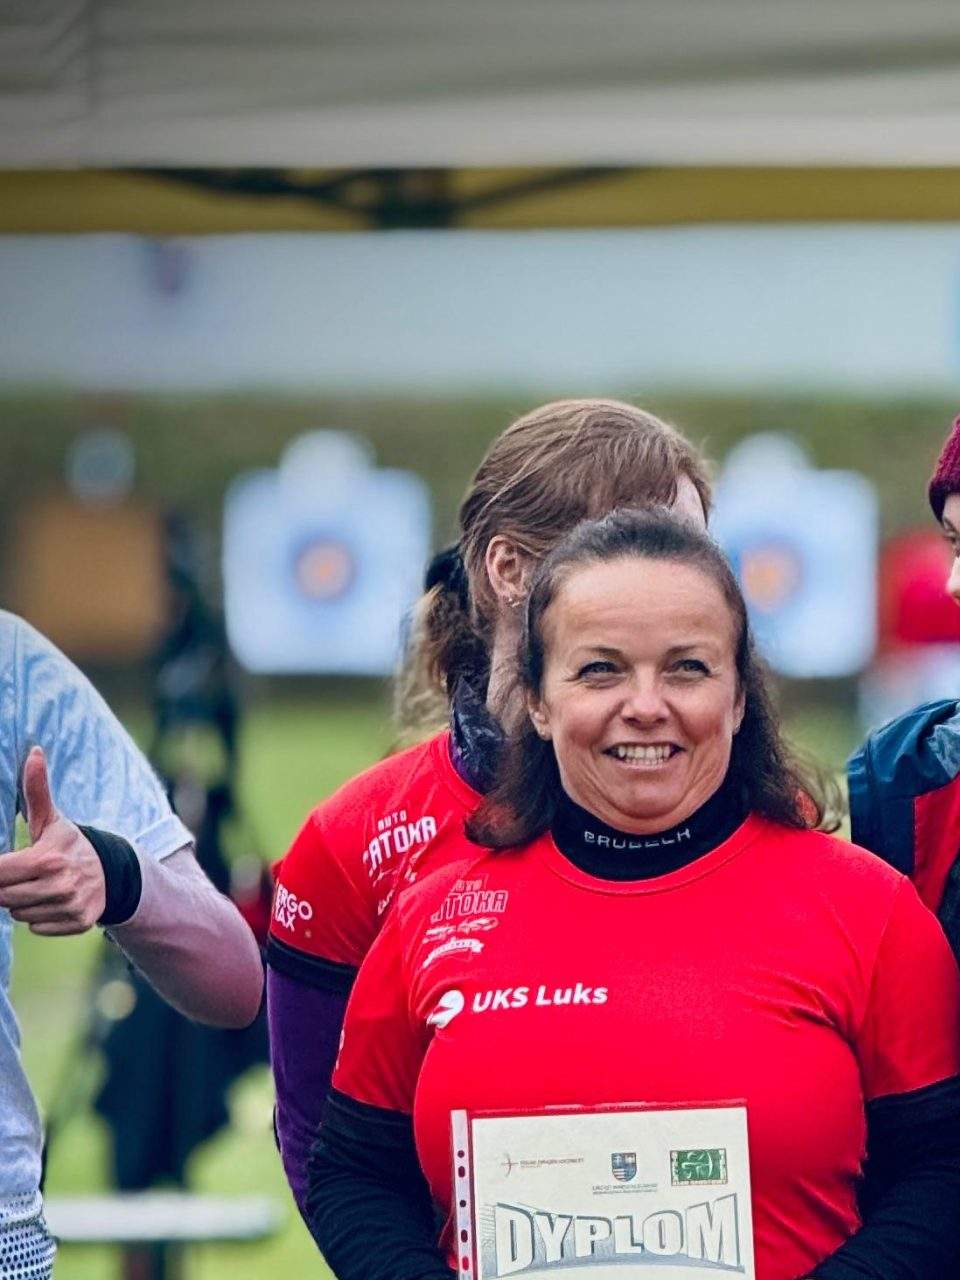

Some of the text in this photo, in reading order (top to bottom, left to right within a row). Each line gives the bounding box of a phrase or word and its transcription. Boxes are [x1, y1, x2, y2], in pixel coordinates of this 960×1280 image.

[378, 810, 407, 831] AUTO
[472, 982, 608, 1013] UKS Luks
[492, 1193, 743, 1278] DYPLOM
